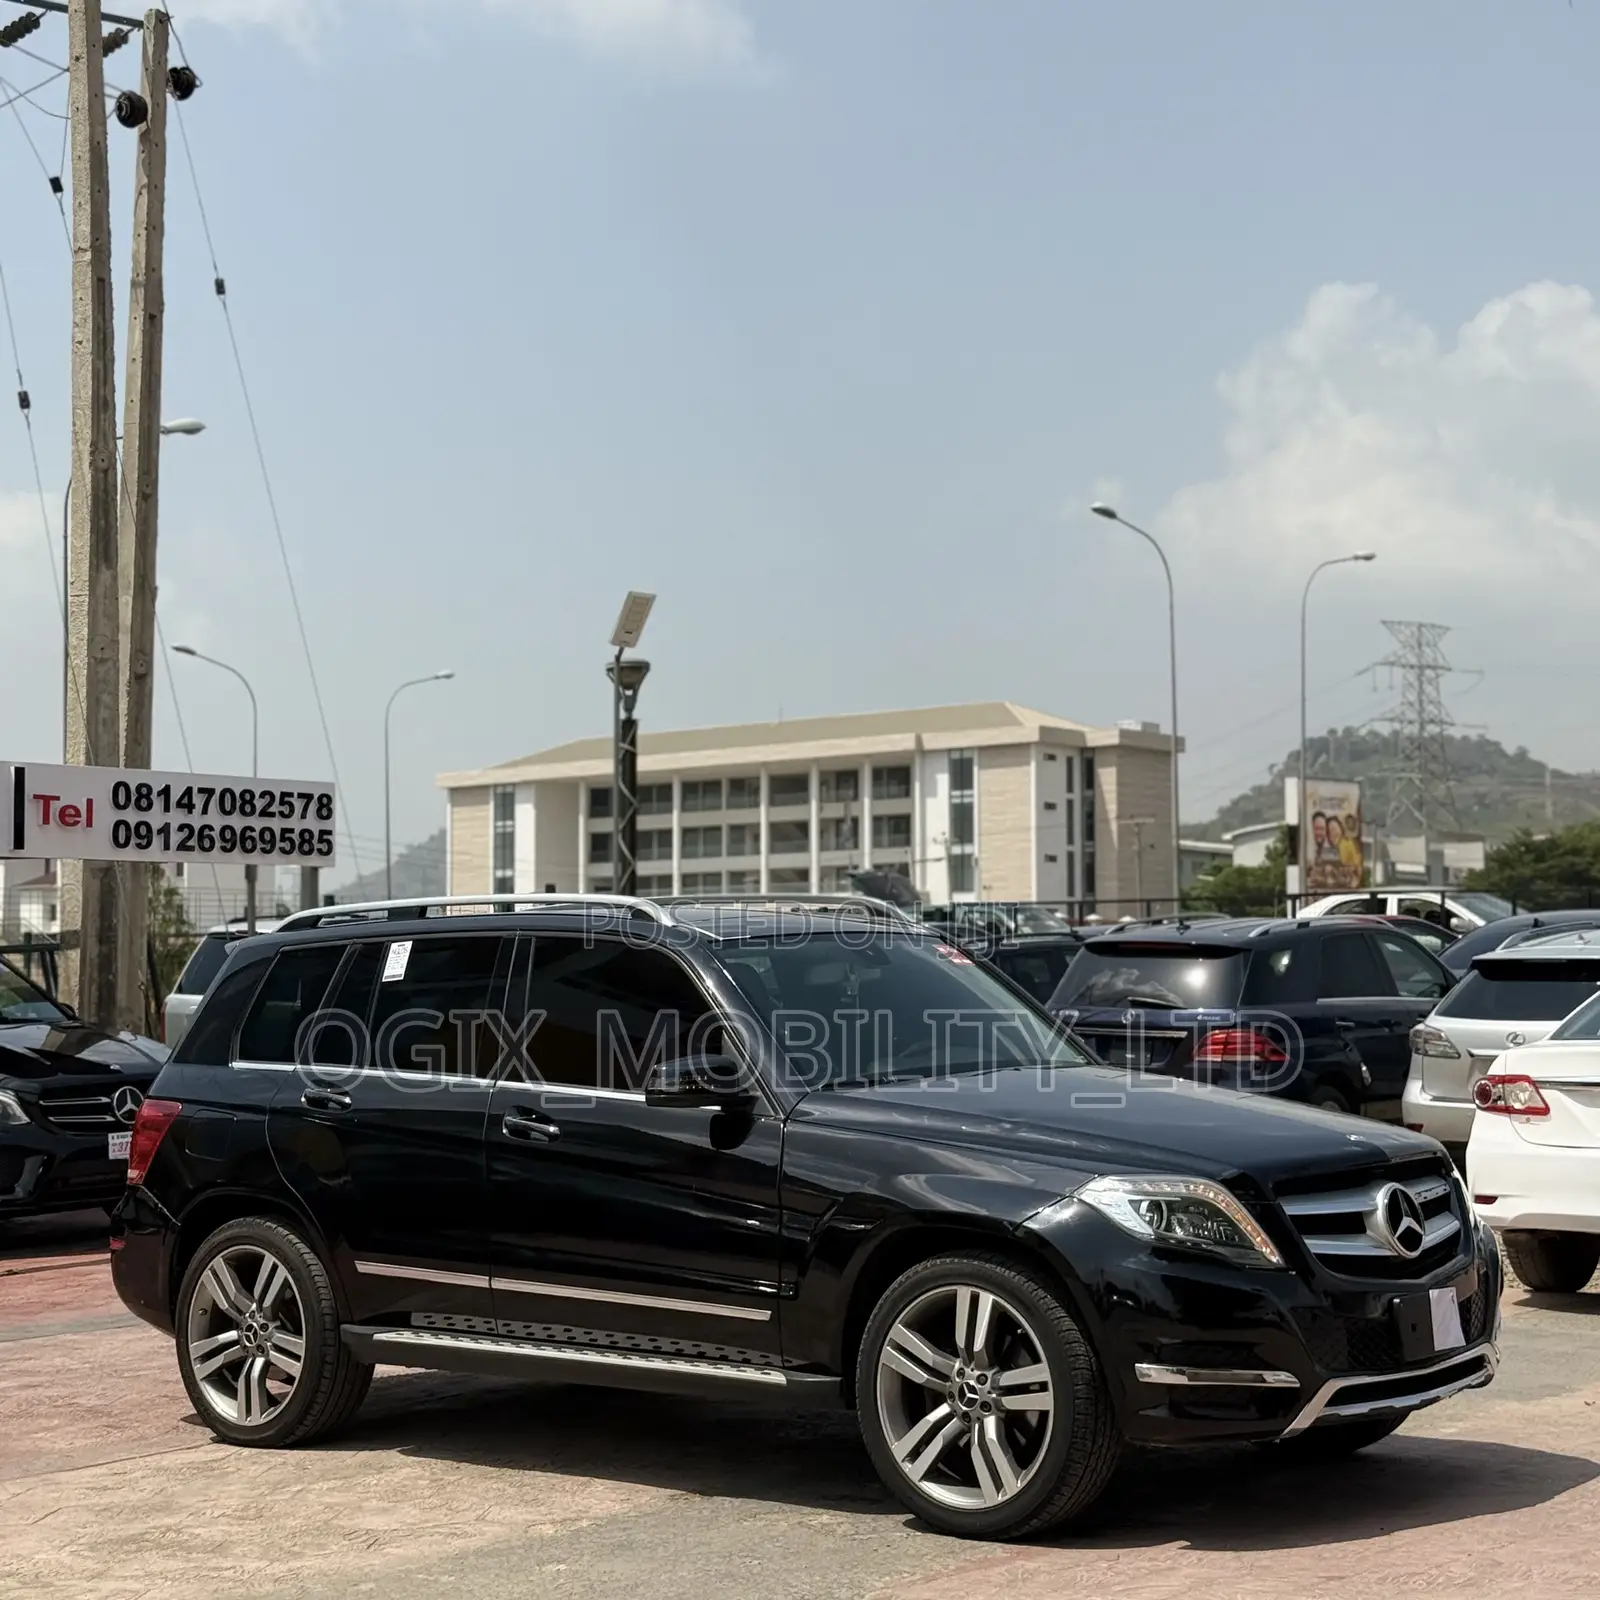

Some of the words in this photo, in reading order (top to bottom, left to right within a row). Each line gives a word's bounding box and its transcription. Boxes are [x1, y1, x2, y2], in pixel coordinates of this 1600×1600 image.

[32, 794, 94, 828] Tel
[111, 781, 334, 821] 08147082578
[111, 819, 334, 857] 09126969585
